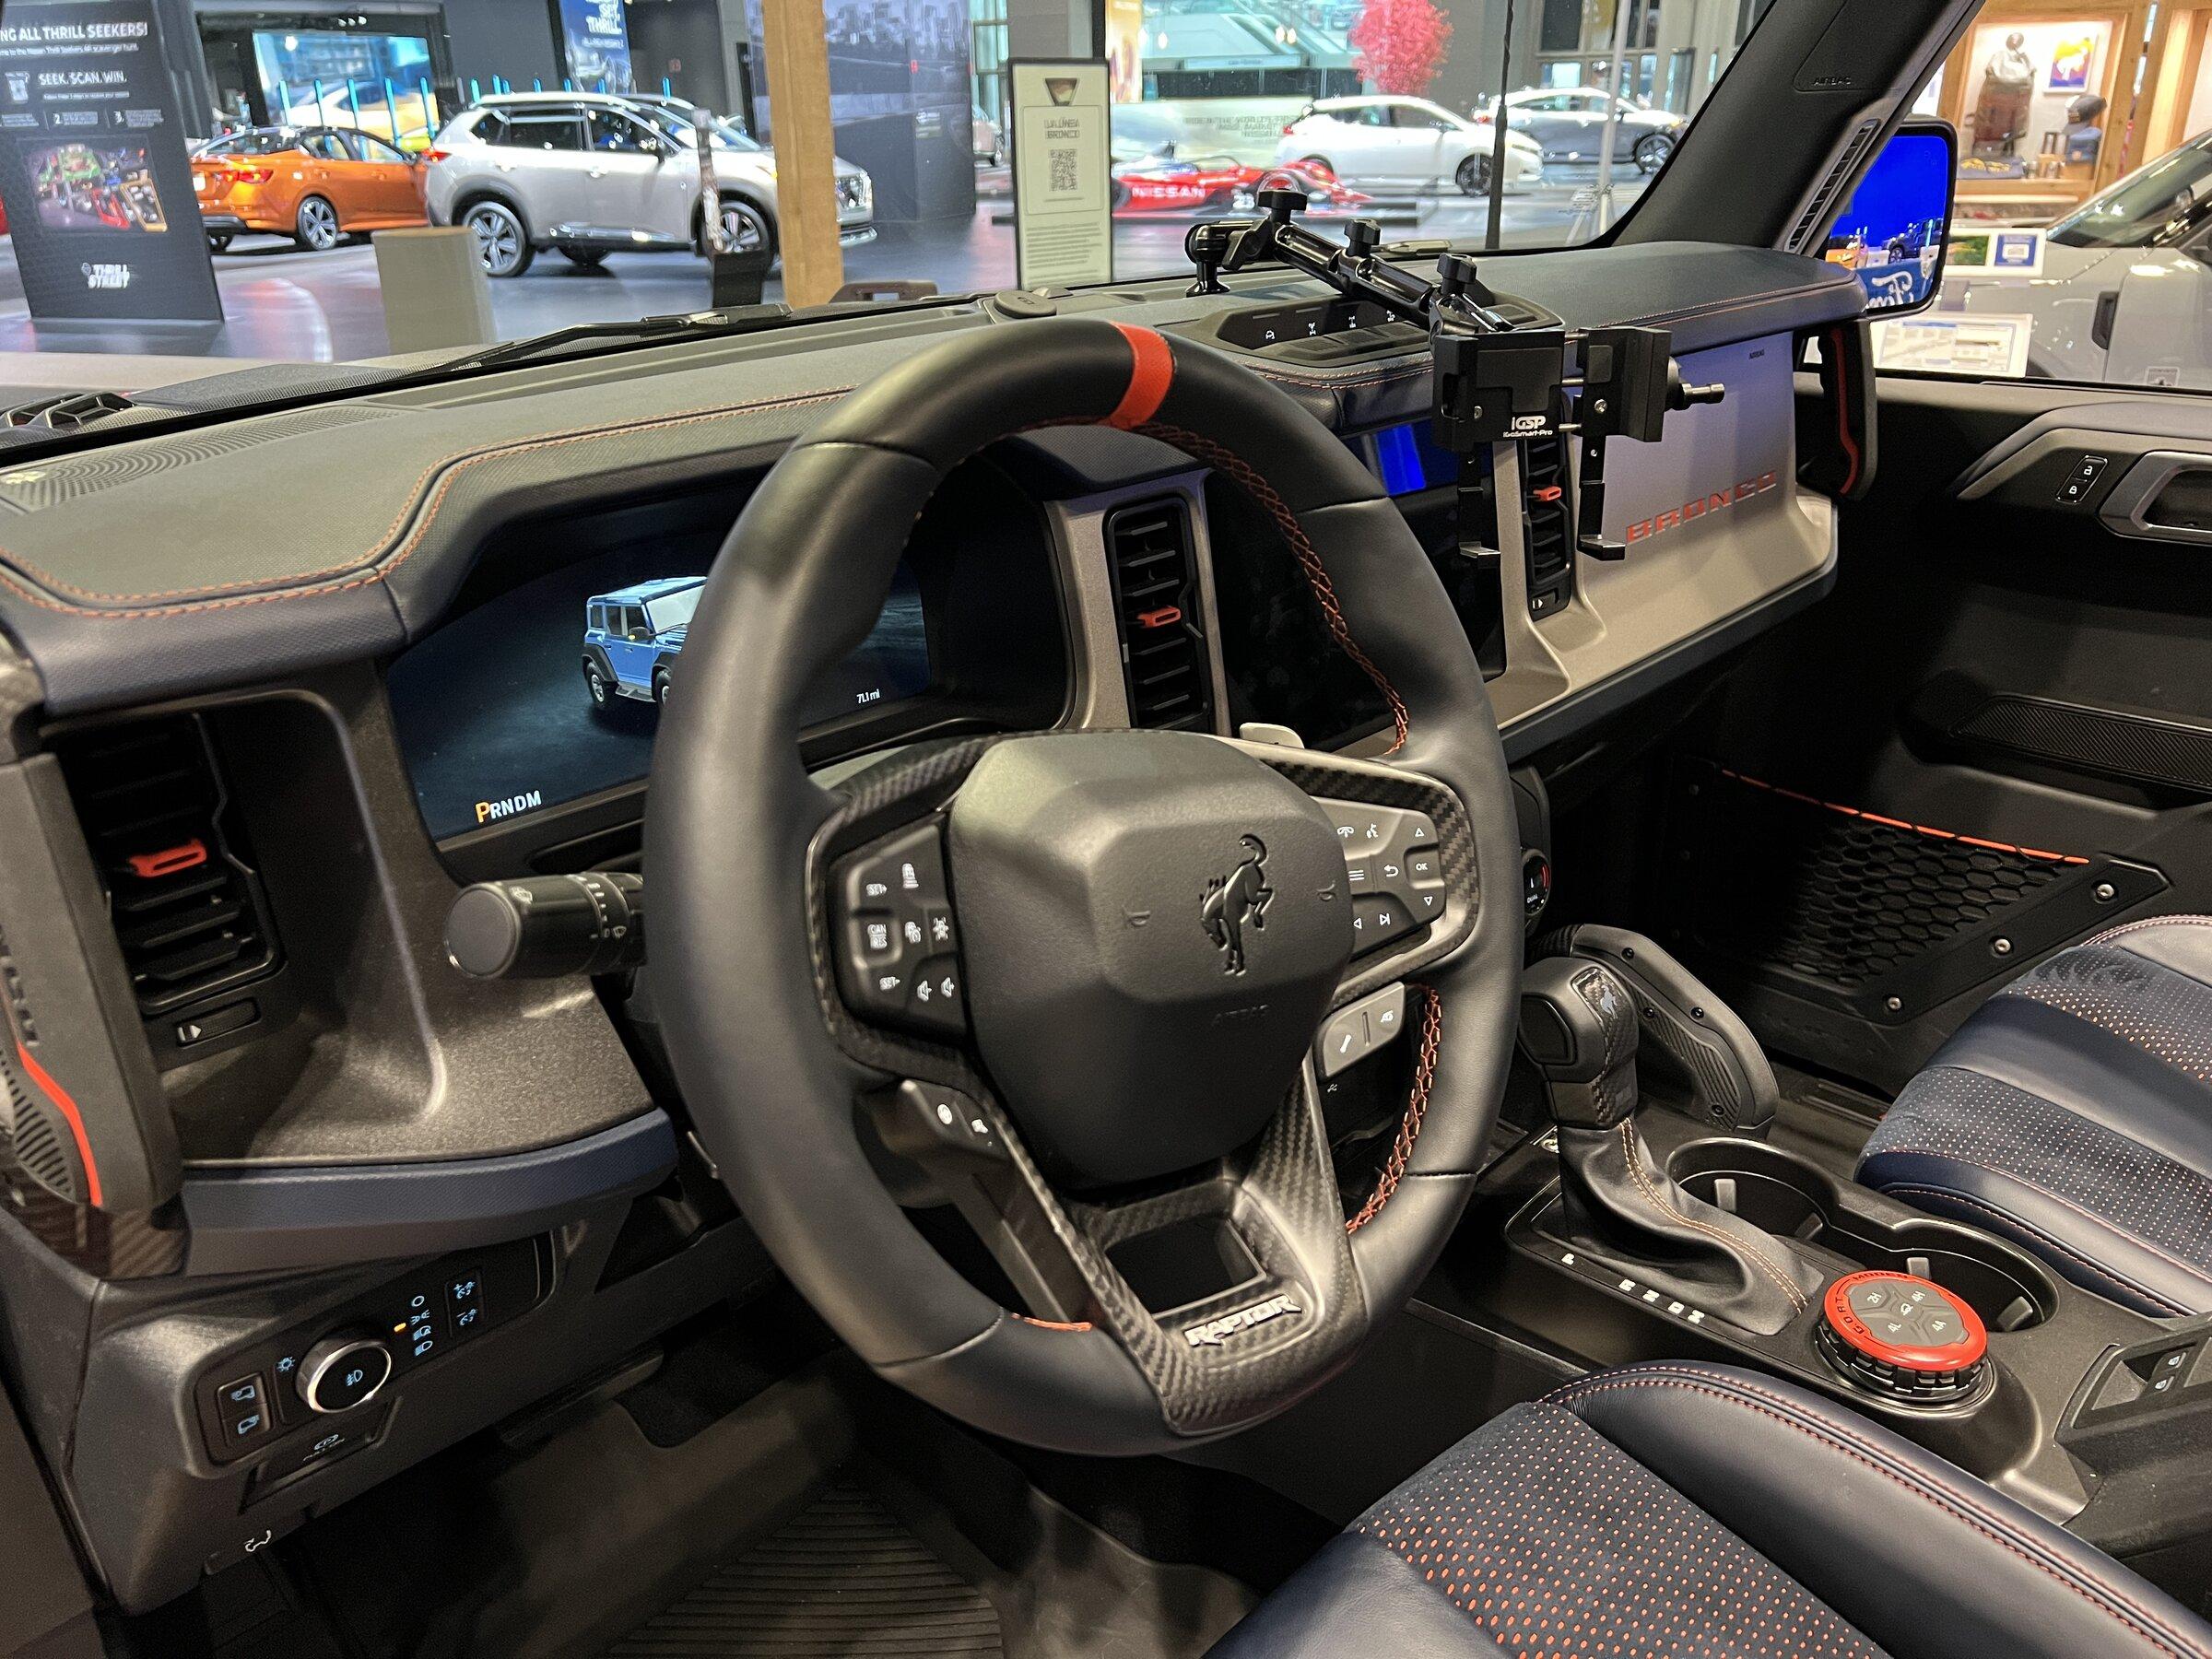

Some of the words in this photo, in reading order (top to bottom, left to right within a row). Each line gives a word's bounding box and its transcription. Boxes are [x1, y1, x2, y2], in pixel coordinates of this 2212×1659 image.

[19, 28, 41, 41] ALL
[42, 25, 85, 40] THRILL
[87, 22, 147, 38] SEEKERS!
[39, 73, 69, 86] SEEK.
[69, 72, 102, 85] SCAN.
[102, 71, 127, 83] WIN.
[1132, 186, 1206, 198] NISSAN
[1627, 470, 1777, 546] BRONCO
[1415, 862, 1428, 871] OK
[1184, 1294, 1302, 1347] RAPTOR
